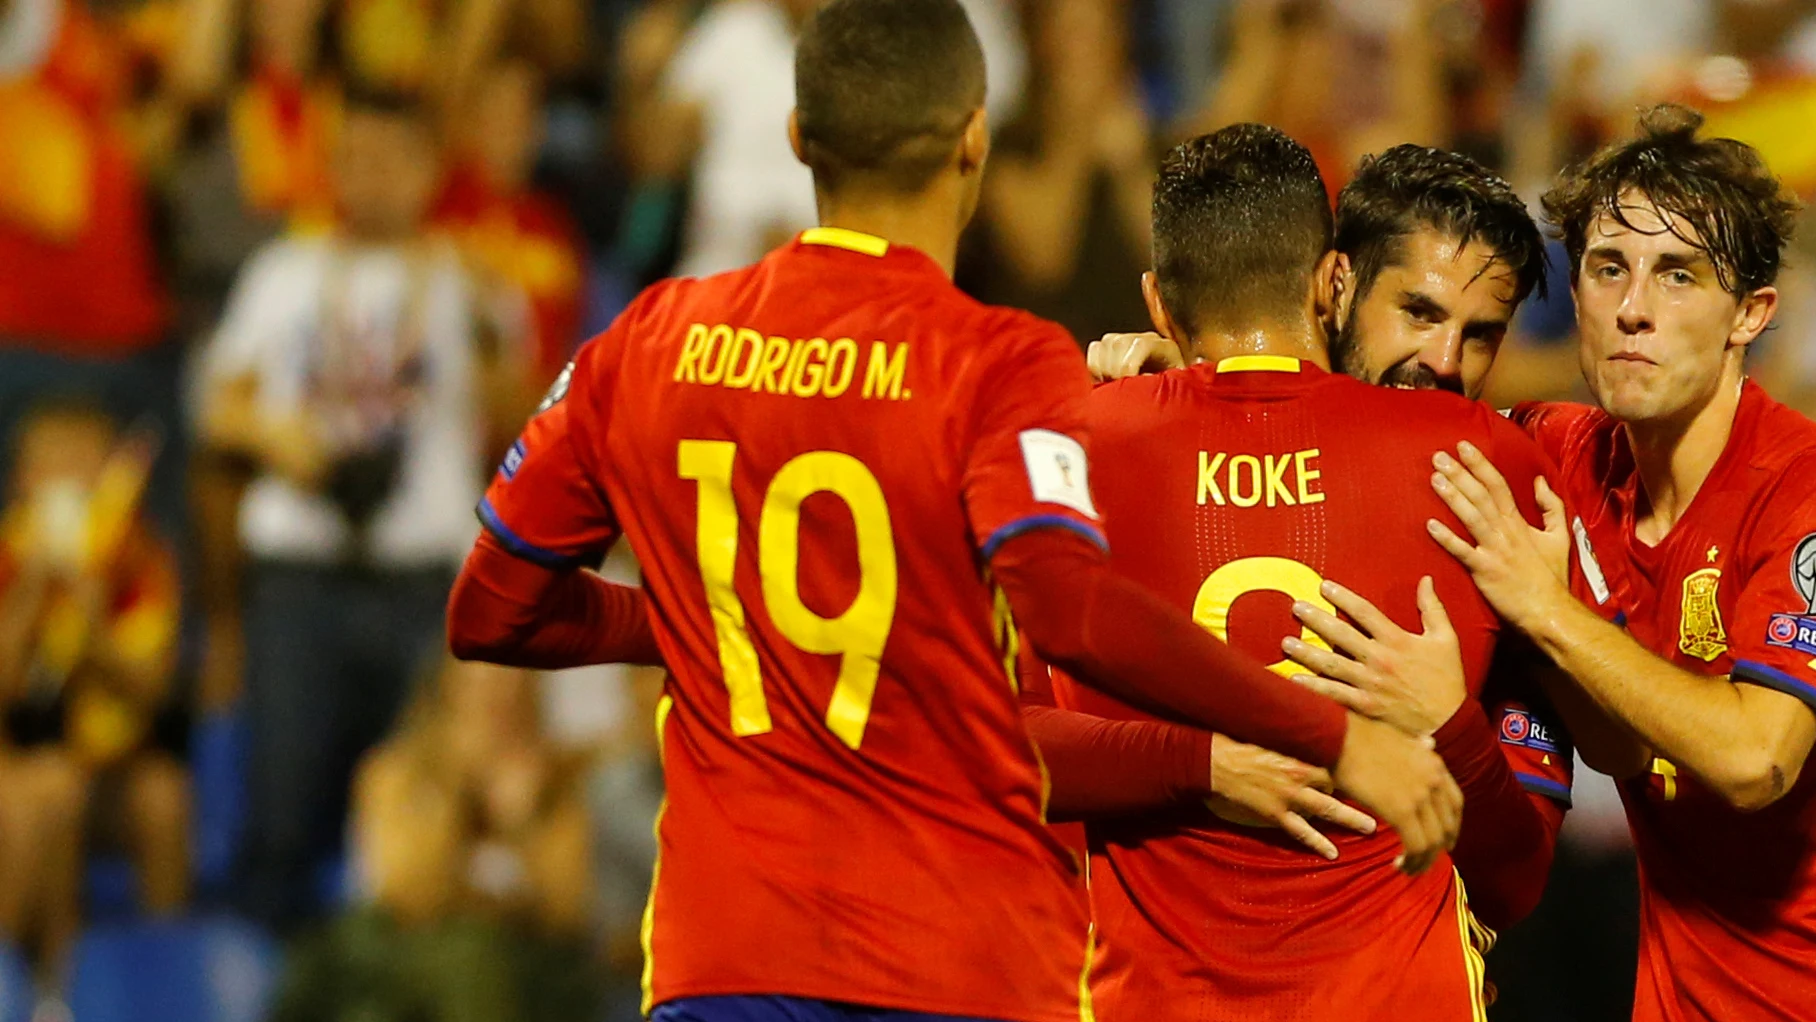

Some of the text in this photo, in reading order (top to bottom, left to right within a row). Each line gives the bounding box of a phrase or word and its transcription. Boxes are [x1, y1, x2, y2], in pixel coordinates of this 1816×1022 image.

[672, 322, 913, 401] RODRIGO M.
[1196, 447, 1327, 509] KOKE
[676, 438, 898, 751] 19
